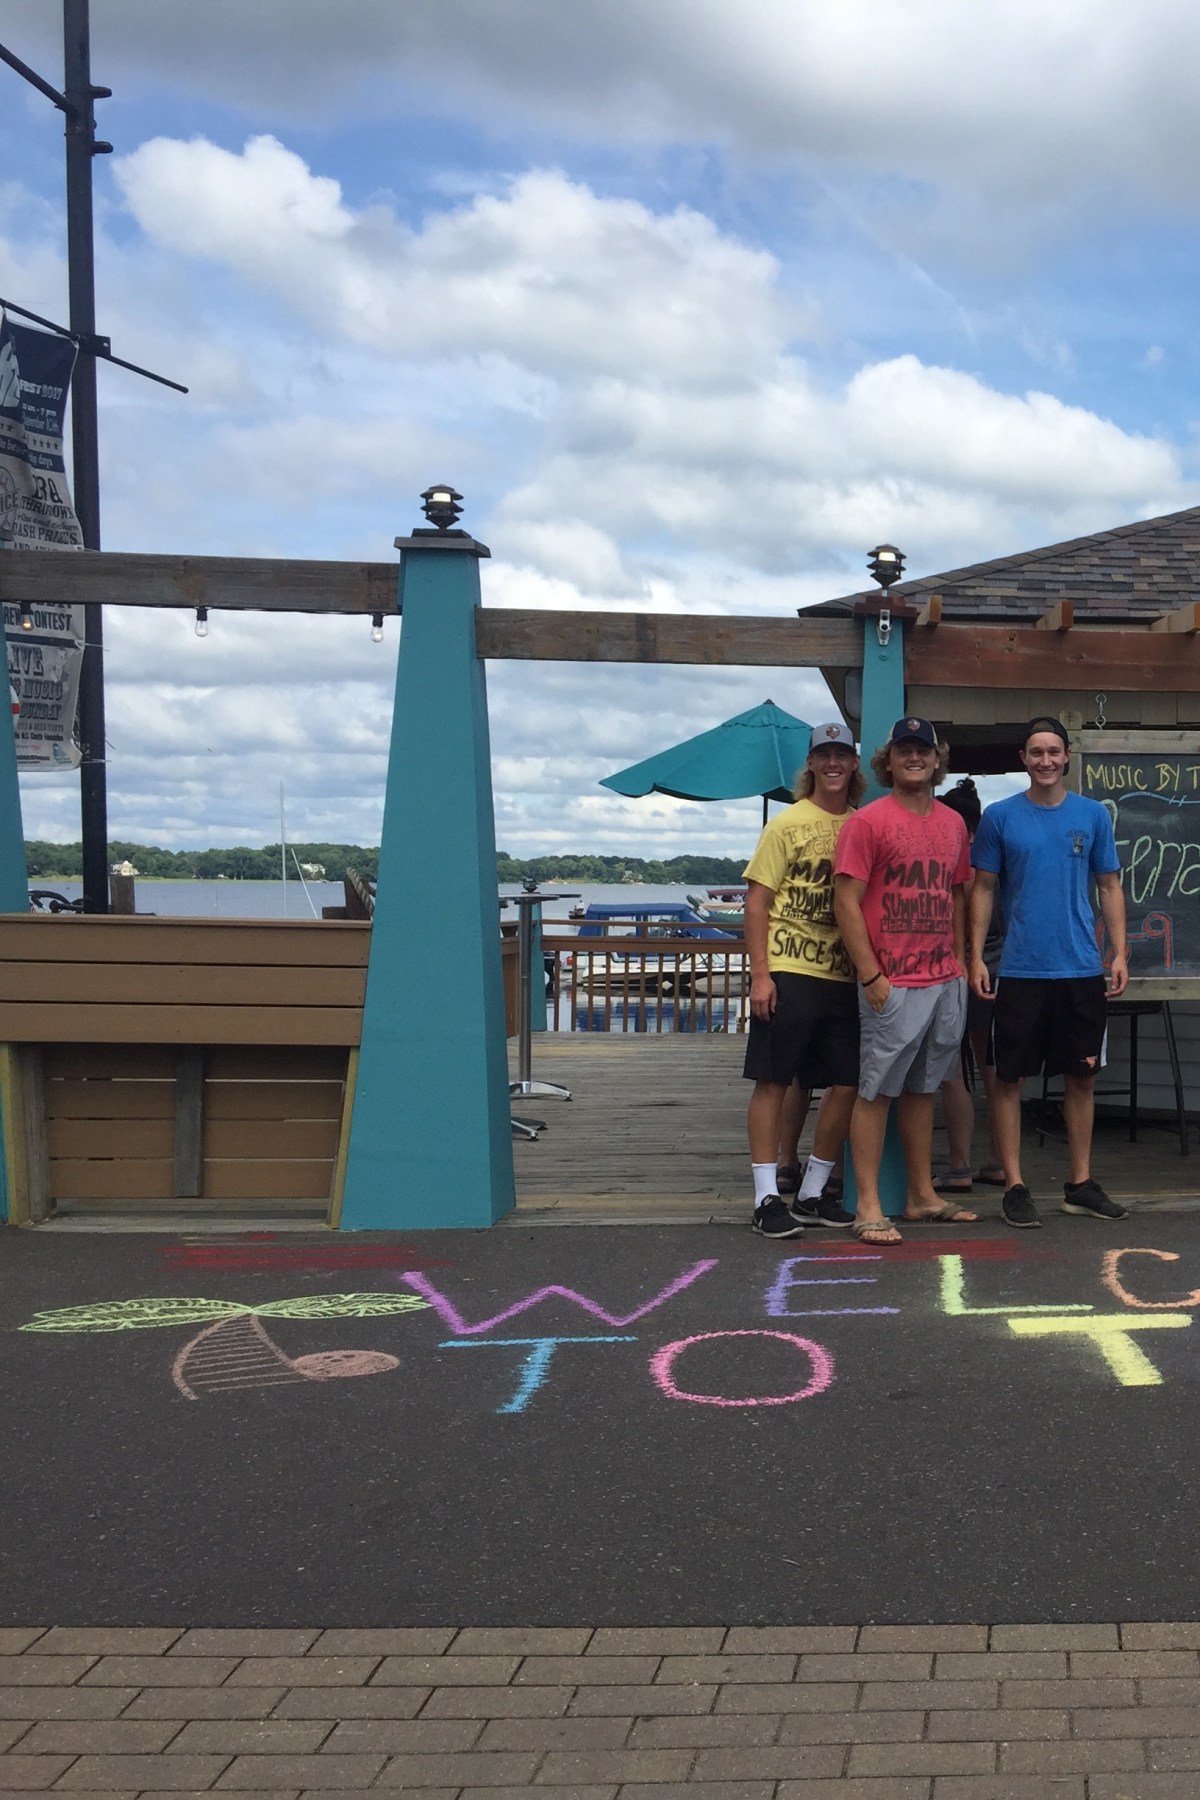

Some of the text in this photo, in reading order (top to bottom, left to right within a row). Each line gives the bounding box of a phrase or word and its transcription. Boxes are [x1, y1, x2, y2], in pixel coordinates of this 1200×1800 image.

[34, 610, 72, 632] ONTEST
[1086, 764, 1148, 790] MUSIC
[1155, 763, 1180, 791] BY
[788, 858, 835, 888] MA
[438, 1330, 835, 1413] TO
